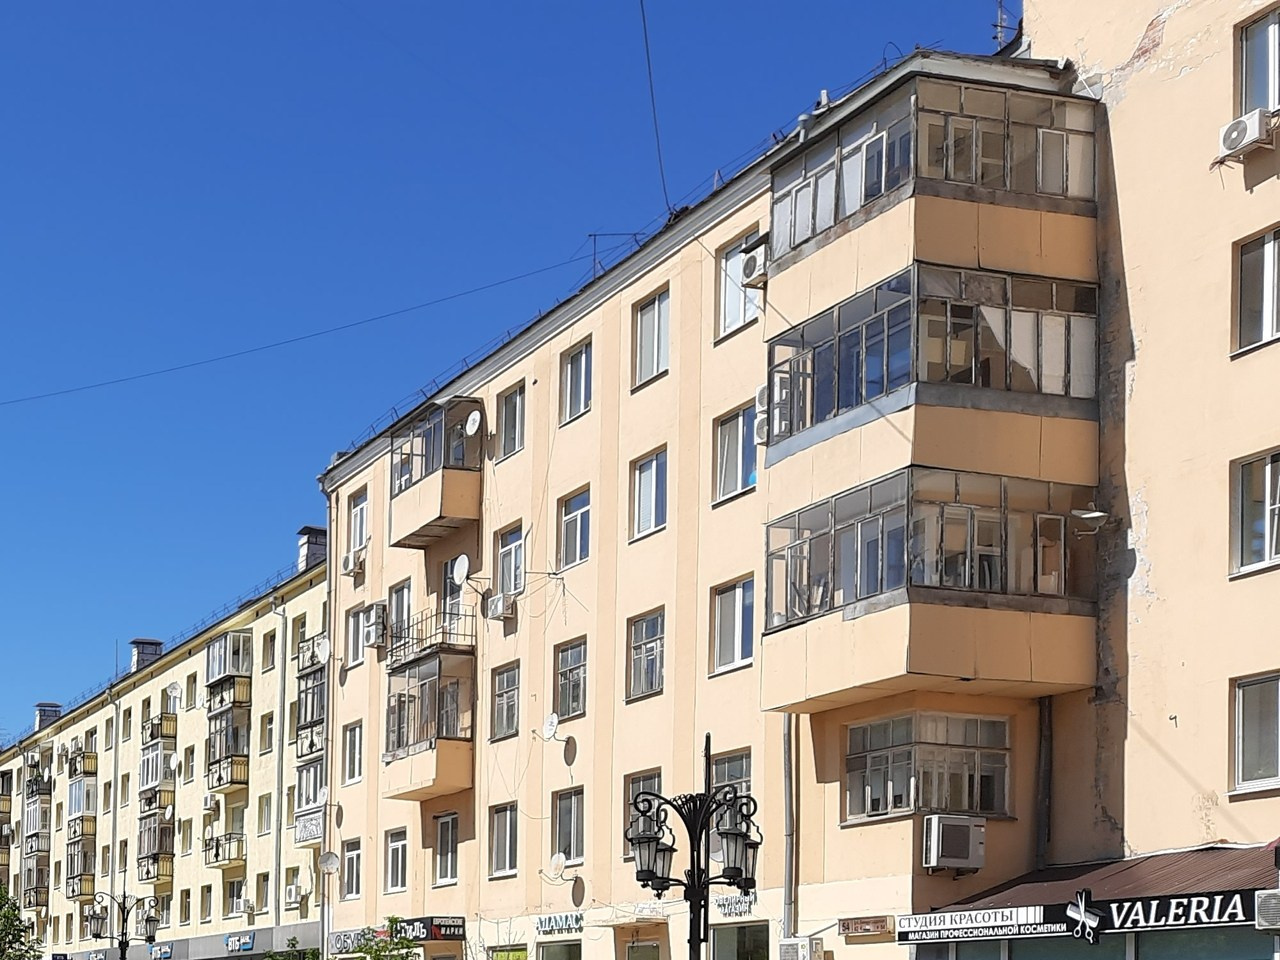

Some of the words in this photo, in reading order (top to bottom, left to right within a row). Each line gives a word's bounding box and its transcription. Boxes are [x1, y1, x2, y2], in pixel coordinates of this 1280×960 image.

[898, 915, 946, 930] СТУДИЯ
[949, 909, 1014, 926] КРАСОТЫ
[1110, 894, 1246, 928] VALERIA
[441, 927, 463, 935] МАРКИ
[908, 931, 939, 940] МАГАЗИН
[940, 926, 1019, 939] ПРОФЕССИОНАЛЬНОЙ
[1020, 923, 1067, 935] КОСМЕТИКИ
[228, 936, 240, 951] ВТБ
